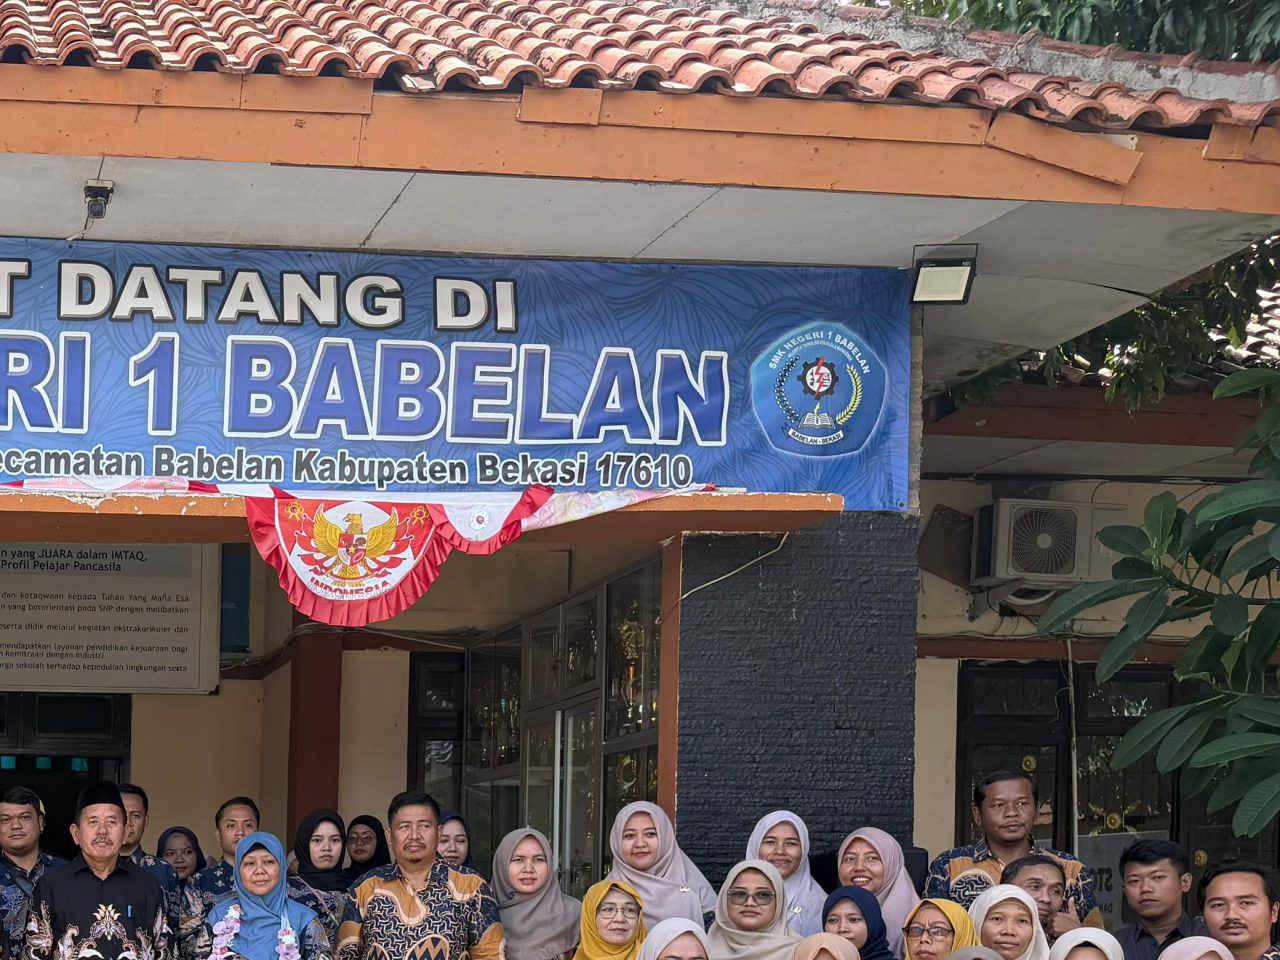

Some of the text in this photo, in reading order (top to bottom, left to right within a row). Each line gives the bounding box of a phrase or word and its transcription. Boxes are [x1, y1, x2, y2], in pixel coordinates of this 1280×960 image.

[58, 260, 405, 329] DATANG
[434, 275, 517, 333] DI
[769, 349, 786, 370] SMK
[784, 331, 824, 349] NEGERI
[827, 331, 833, 340] 1
[835, 334, 870, 375] BABELAN
[128, 332, 179, 436] 1
[224, 335, 727, 445] BABELAN
[791, 431, 818, 444] BABELAN
[153, 446, 282, 481] Babelan
[294, 448, 466, 489] Kabupaten
[478, 454, 586, 487] Bekasi
[595, 454, 691, 487] 17610
[1, 559, 30, 570] Profil
[33, 560, 70, 572] Pelajar
[73, 561, 121, 572] Pancasila
[11, 550, 35, 560] yang
[39, 549, 73, 559] JUARA
[76, 549, 107, 559] dalam
[111, 551, 147, 562] IMTAQ,
[308, 577, 393, 597] INDONESIA
[8, 604, 26, 612] yang
